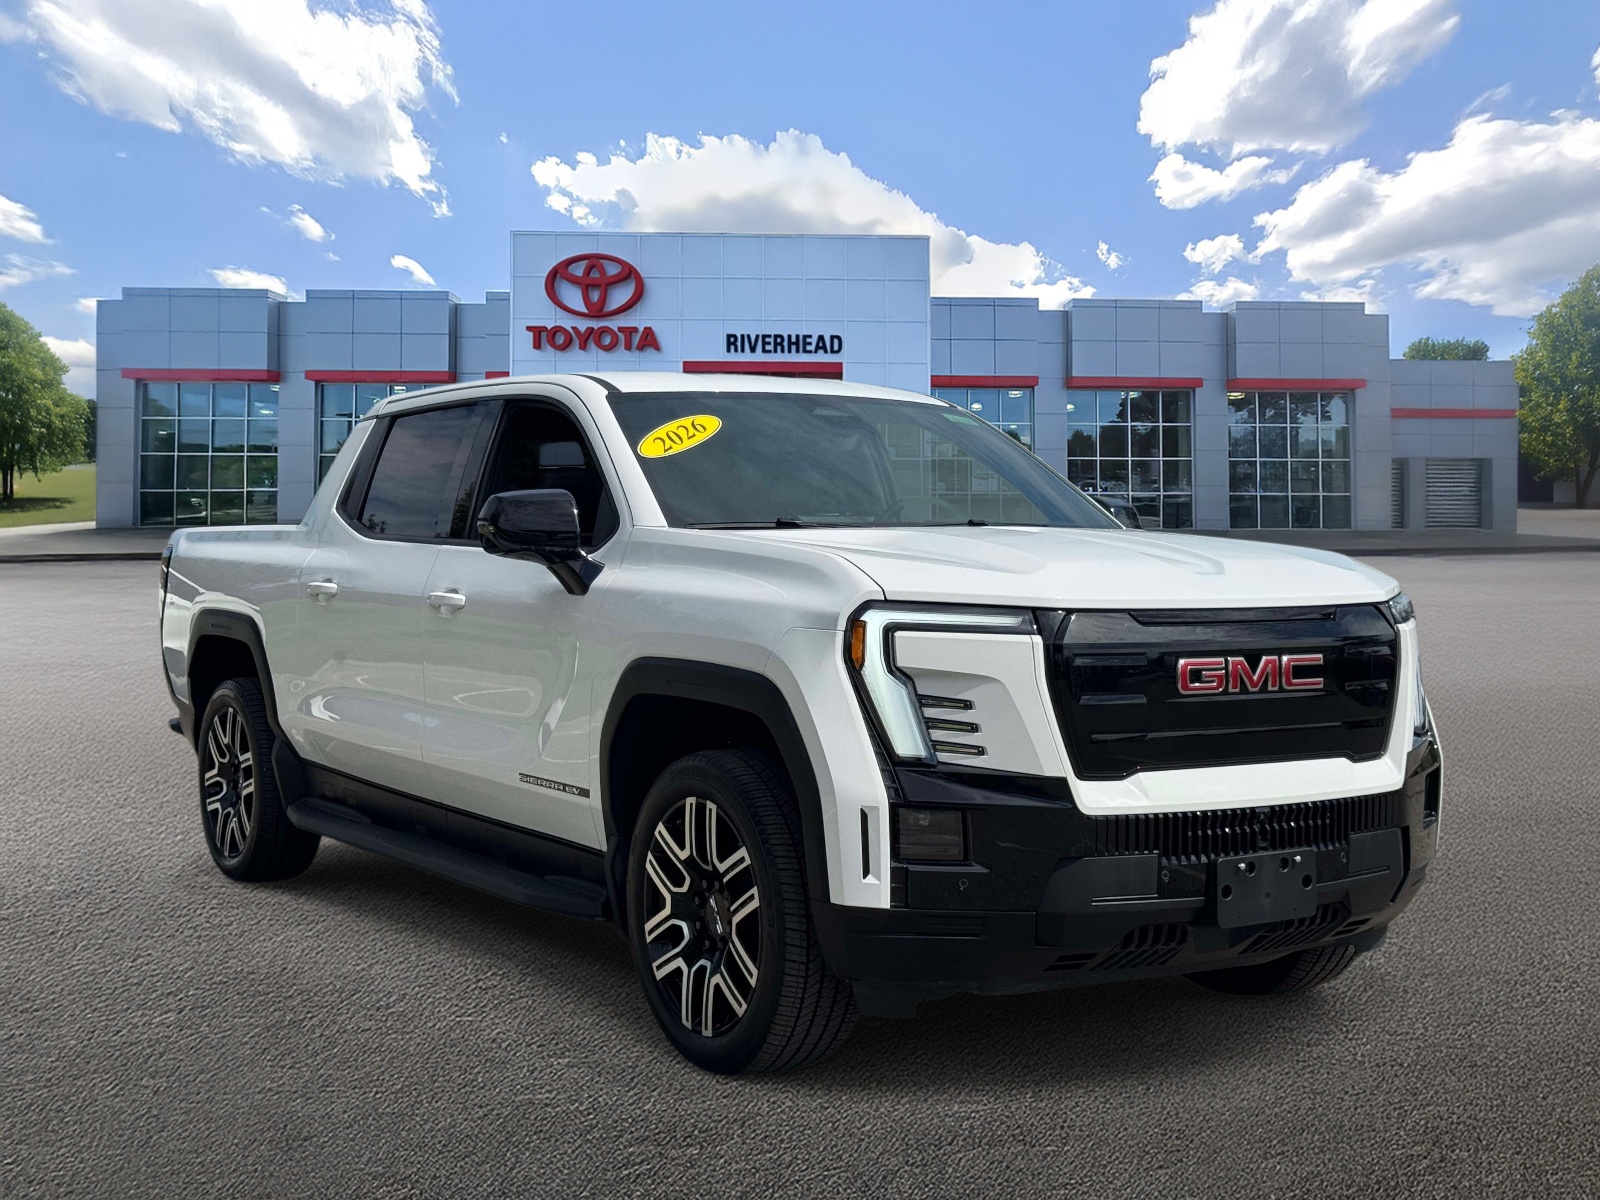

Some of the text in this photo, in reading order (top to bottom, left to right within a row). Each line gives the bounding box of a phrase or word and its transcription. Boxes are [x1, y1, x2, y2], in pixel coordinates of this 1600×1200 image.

[526, 326, 661, 352] TOYOTA
[725, 333, 844, 355] RIVERHEAD
[652, 418, 707, 454] 2026
[1177, 653, 1324, 695] GMC
[519, 774, 581, 795] SIERRA EV
